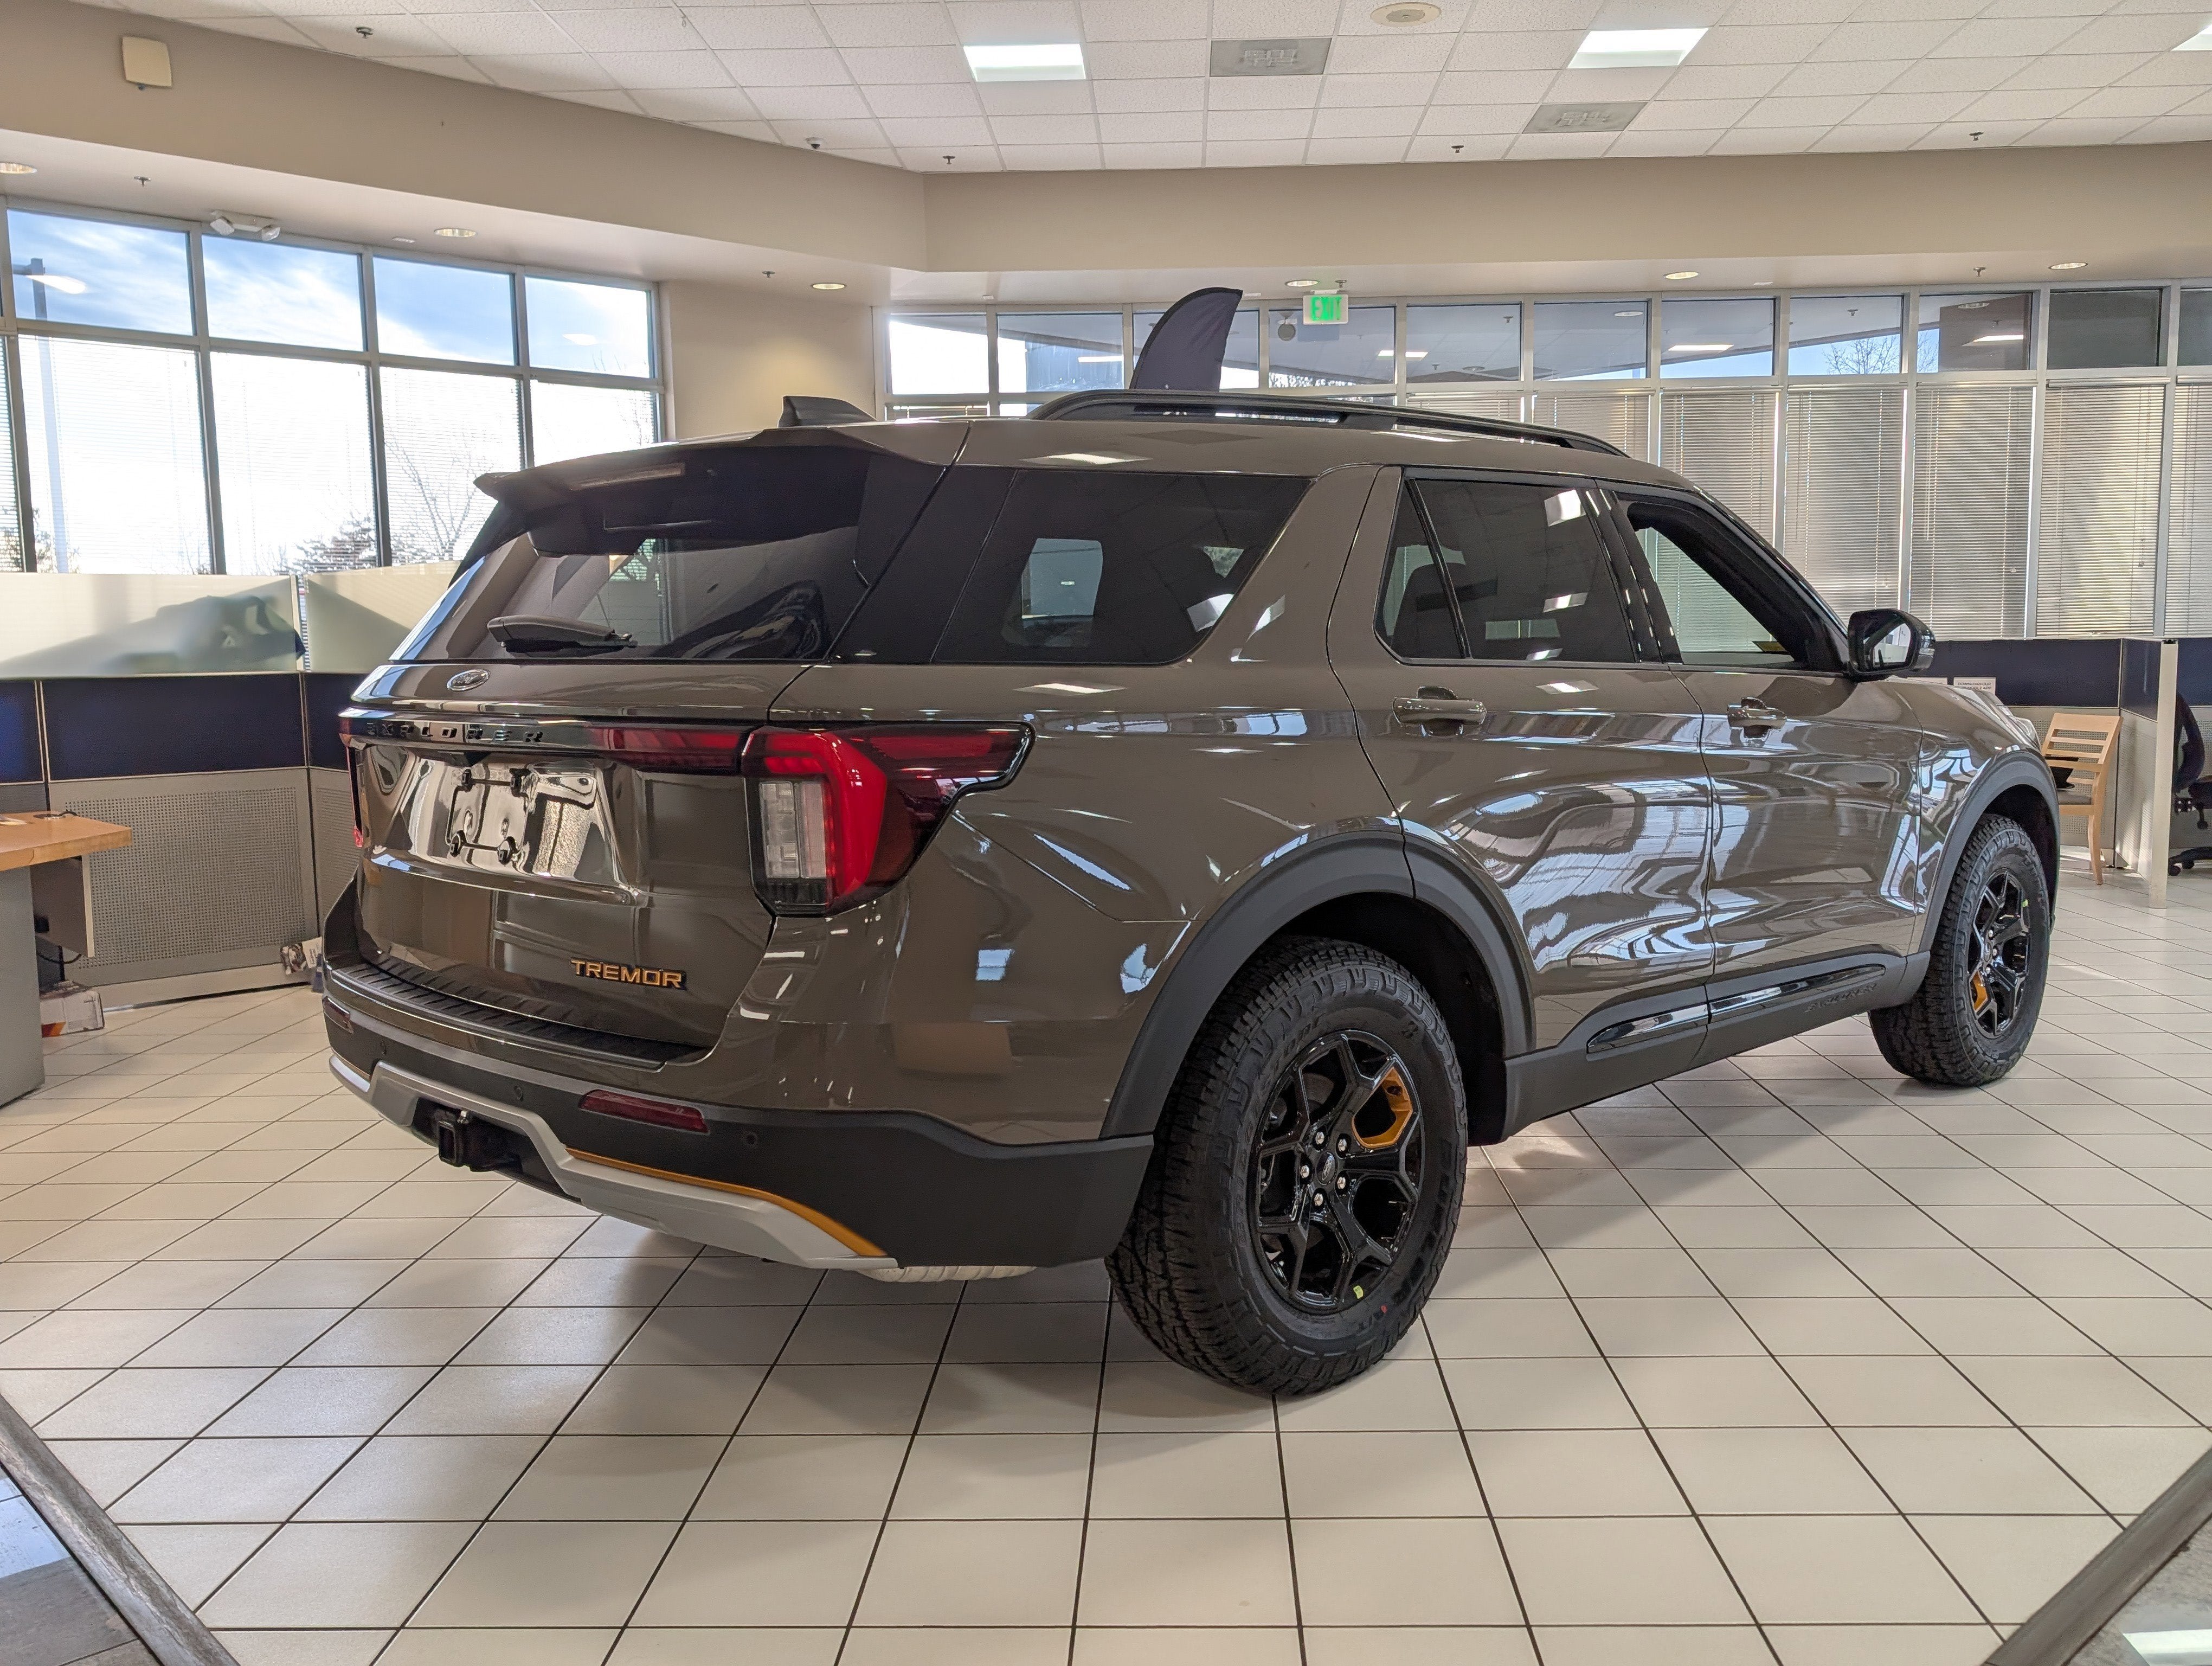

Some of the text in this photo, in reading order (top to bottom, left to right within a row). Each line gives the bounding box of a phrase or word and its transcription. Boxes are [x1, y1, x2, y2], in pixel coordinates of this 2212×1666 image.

[1311, 297, 1342, 321] EXIT
[366, 723, 543, 743] EXPLORER
[570, 958, 684, 989] TREMOR
